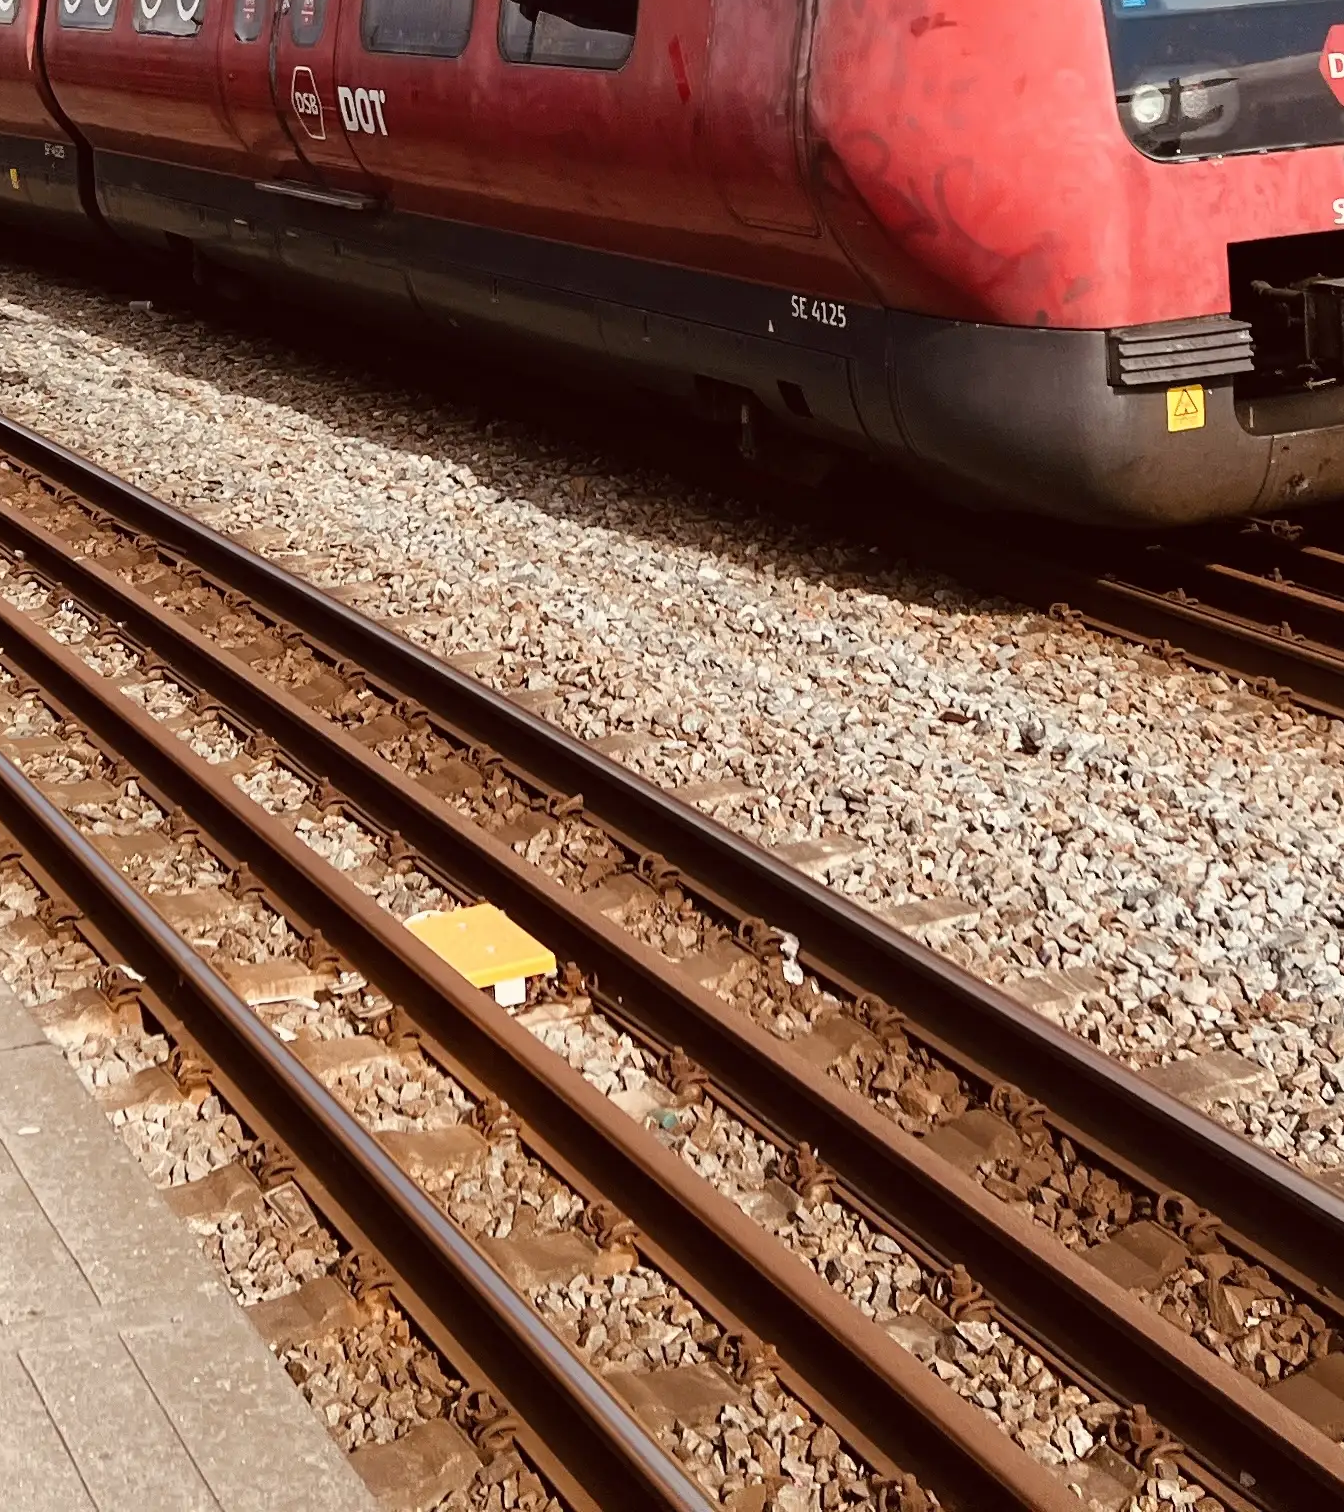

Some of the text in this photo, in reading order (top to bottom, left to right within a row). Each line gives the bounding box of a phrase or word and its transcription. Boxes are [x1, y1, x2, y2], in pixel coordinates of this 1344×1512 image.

[294, 91, 319, 115] DSB
[337, 85, 388, 137] DOT
[791, 294, 847, 328] SE 4125
